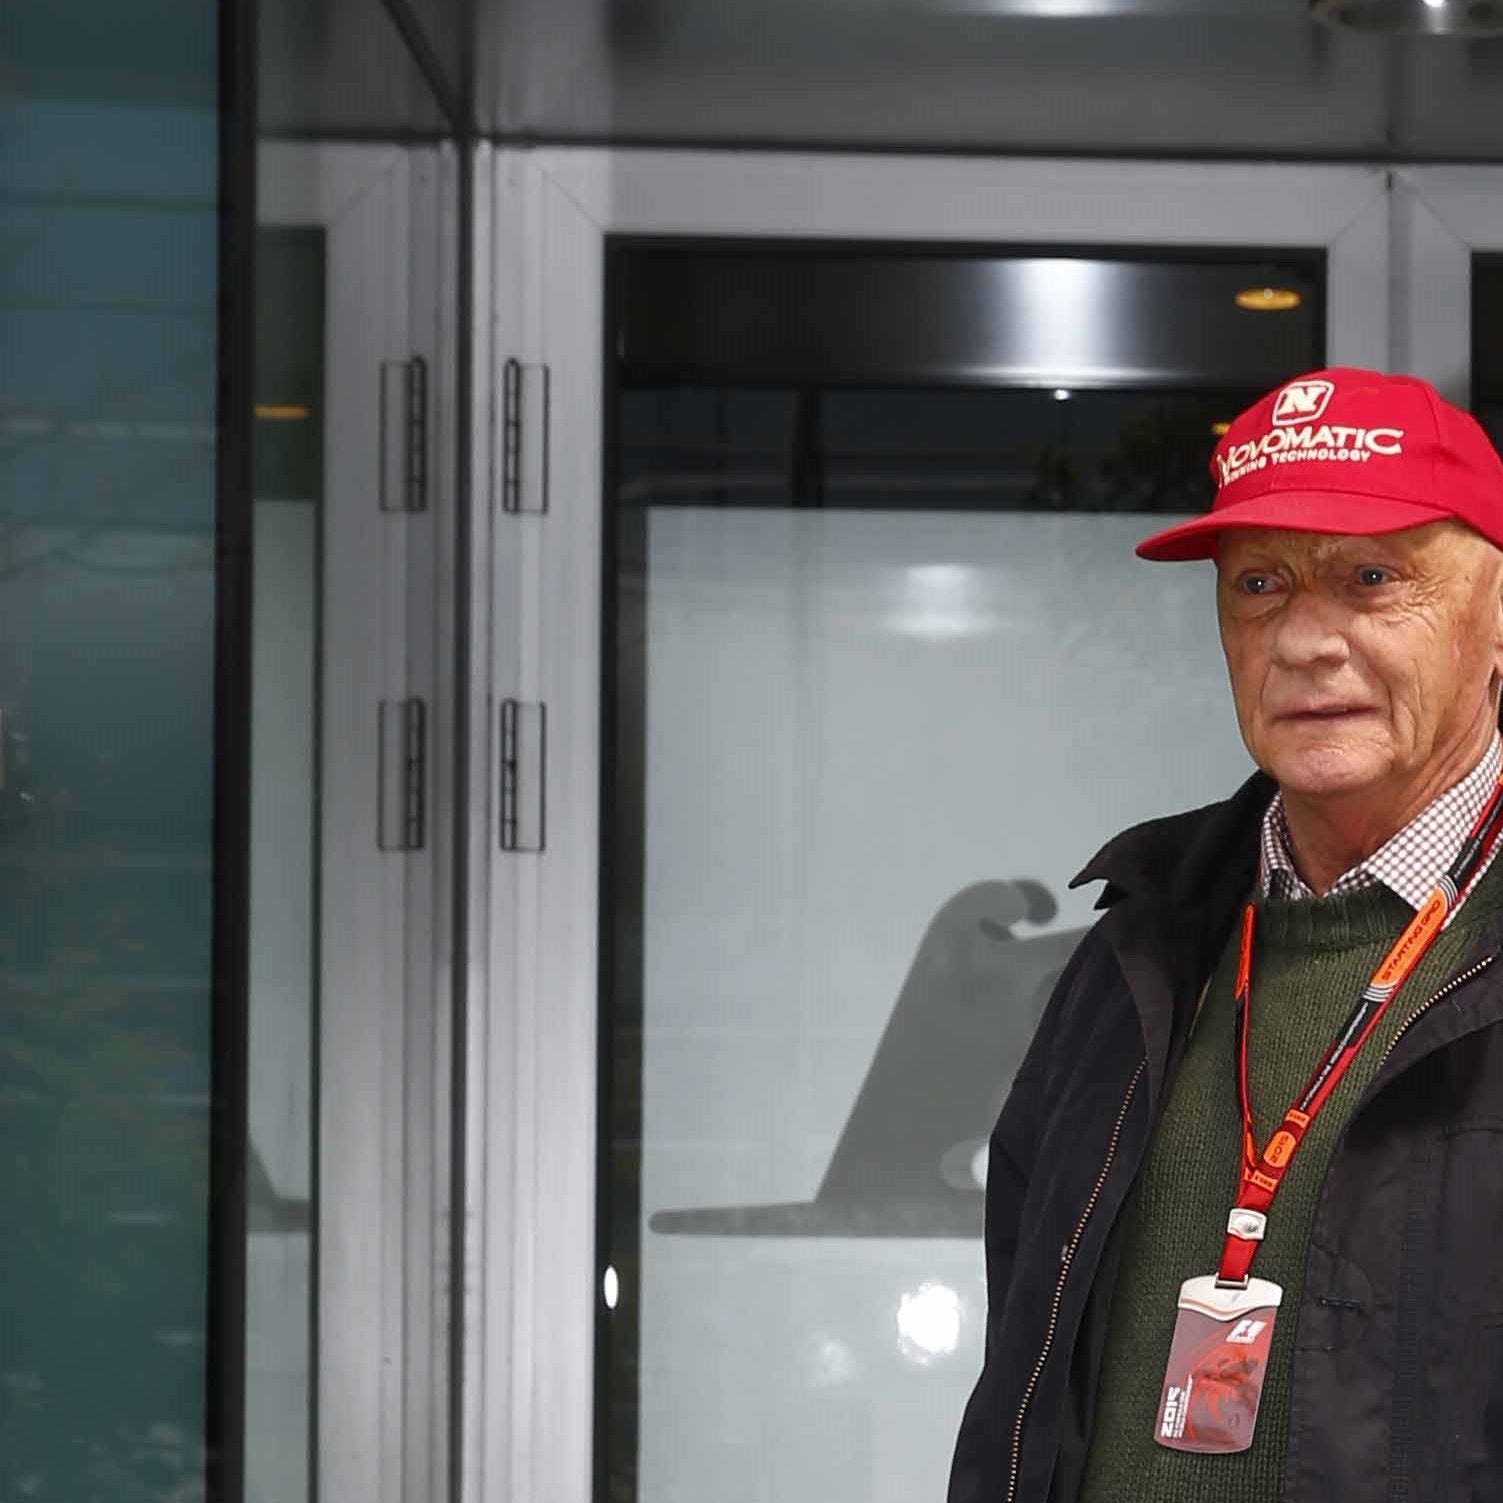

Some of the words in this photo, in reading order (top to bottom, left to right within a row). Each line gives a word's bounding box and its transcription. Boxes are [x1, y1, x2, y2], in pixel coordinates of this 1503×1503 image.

[1276, 385, 1328, 416] N
[1216, 425, 1404, 488] NOVOMATIC
[1271, 448, 1371, 465] TECHNOLOGY
[1380, 924, 1424, 982] STARTING
